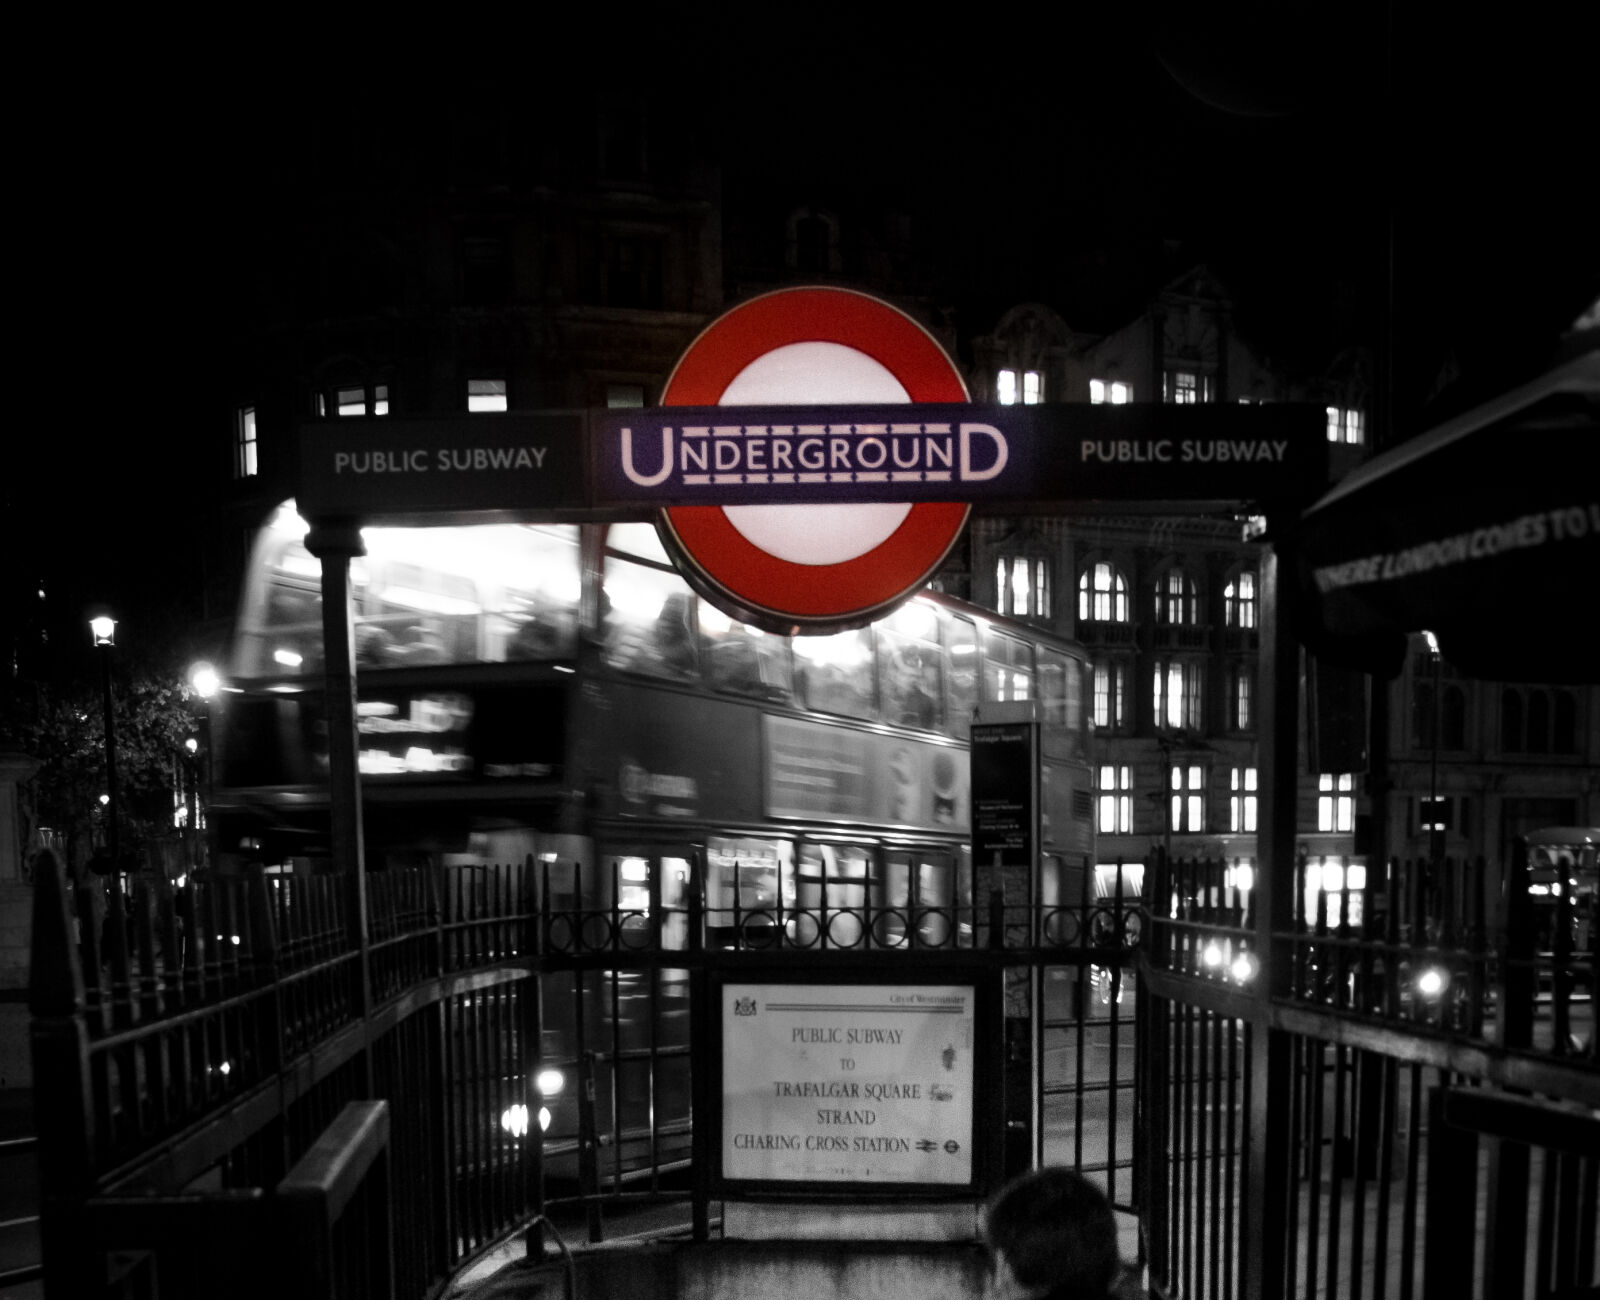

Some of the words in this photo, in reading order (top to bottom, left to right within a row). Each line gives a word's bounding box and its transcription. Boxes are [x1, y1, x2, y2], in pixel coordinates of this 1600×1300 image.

[334, 449, 429, 474] PUBLIC
[437, 446, 548, 472] SUBWAY
[621, 423, 1011, 487] UNDERGROUND
[1080, 439, 1173, 463] PUBLIC
[1181, 439, 1288, 463] SUBWAY
[1382, 532, 1472, 580] LONDON
[1550, 506, 1588, 541] TO
[791, 1026, 842, 1043] PUBLIC
[846, 1028, 904, 1045] SUBWAY
[839, 1057, 856, 1071] TO
[774, 1080, 860, 1098] TRAFALGAR
[863, 1083, 922, 1102] SQUARE
[816, 1109, 877, 1126] STRAND
[733, 1133, 801, 1150] CHARING
[805, 1134, 849, 1151] CROSS
[853, 1136, 910, 1153] STATION
